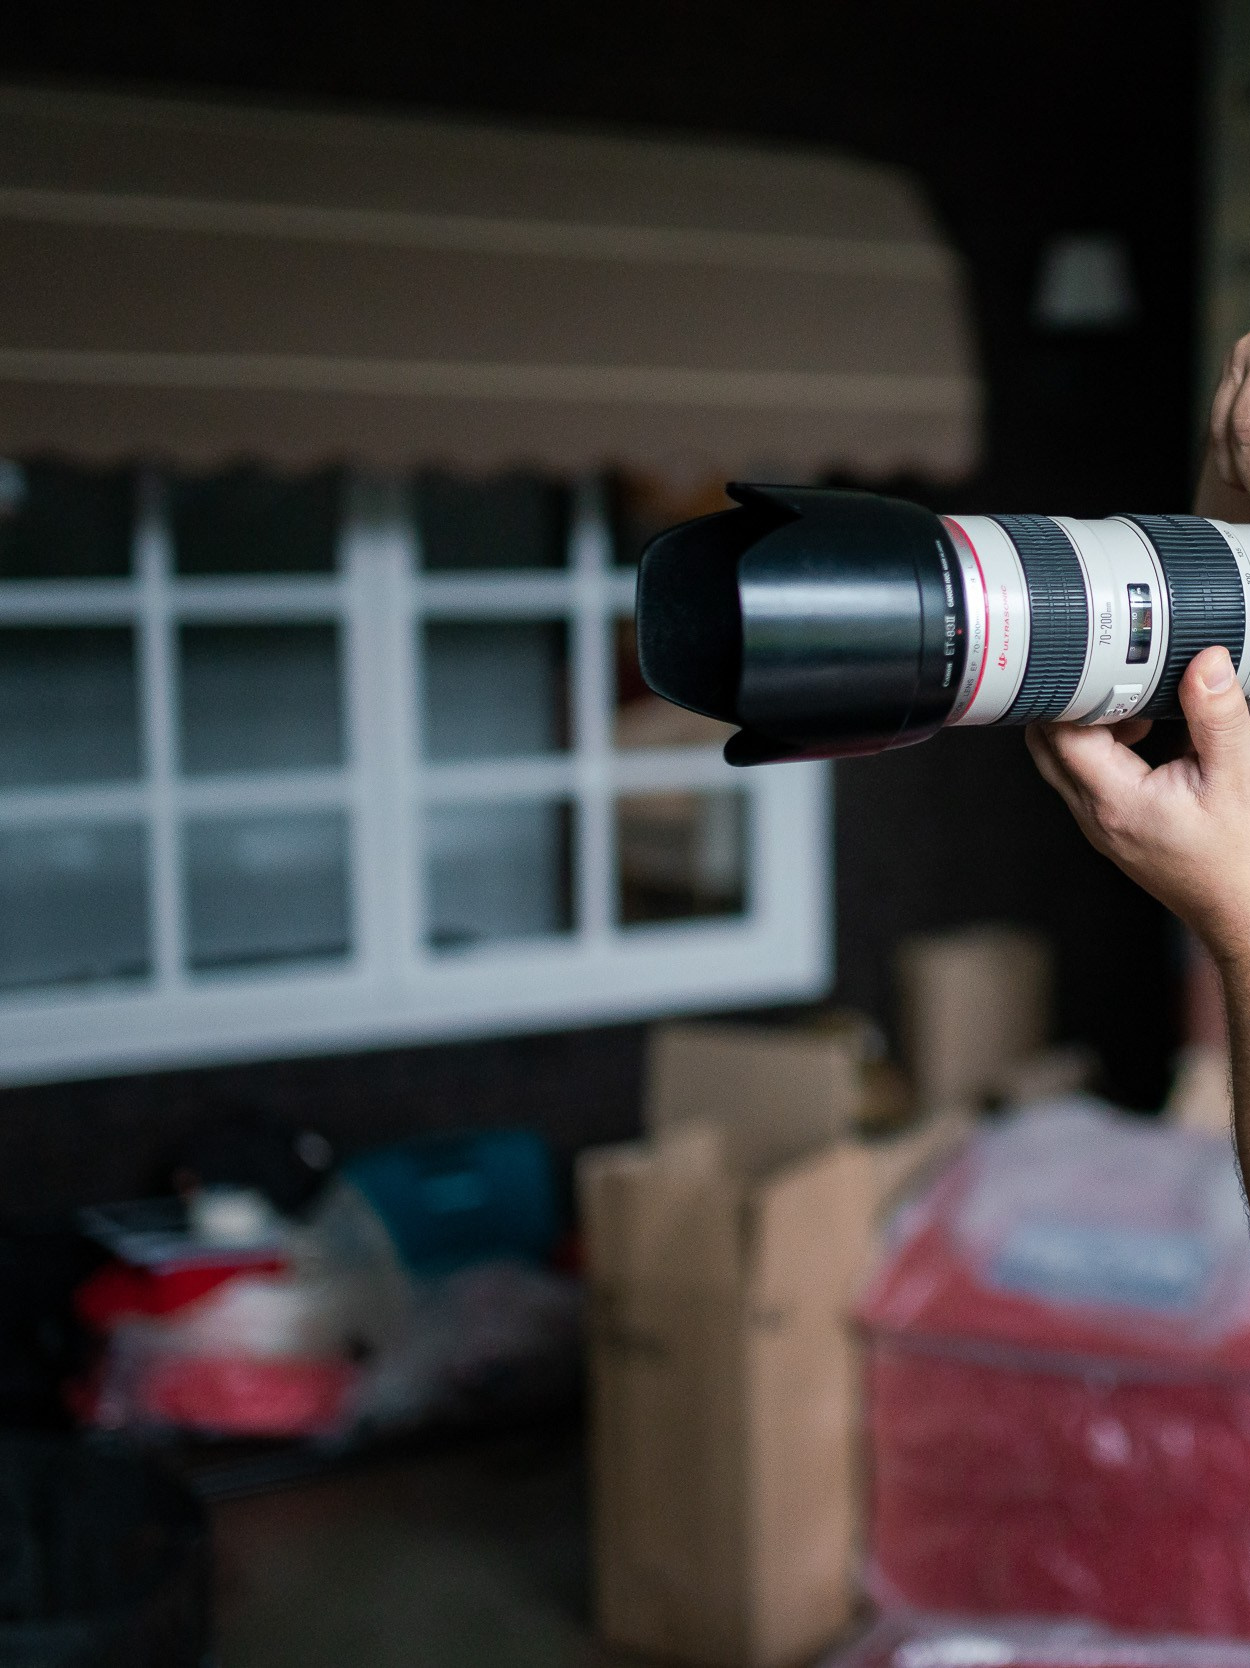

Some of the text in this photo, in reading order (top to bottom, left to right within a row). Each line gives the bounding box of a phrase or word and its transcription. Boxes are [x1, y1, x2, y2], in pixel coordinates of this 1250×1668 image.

[1000, 584, 1011, 652] ULTRASONIC
[963, 678, 975, 697] LENS
[970, 662, 978, 672] EF
